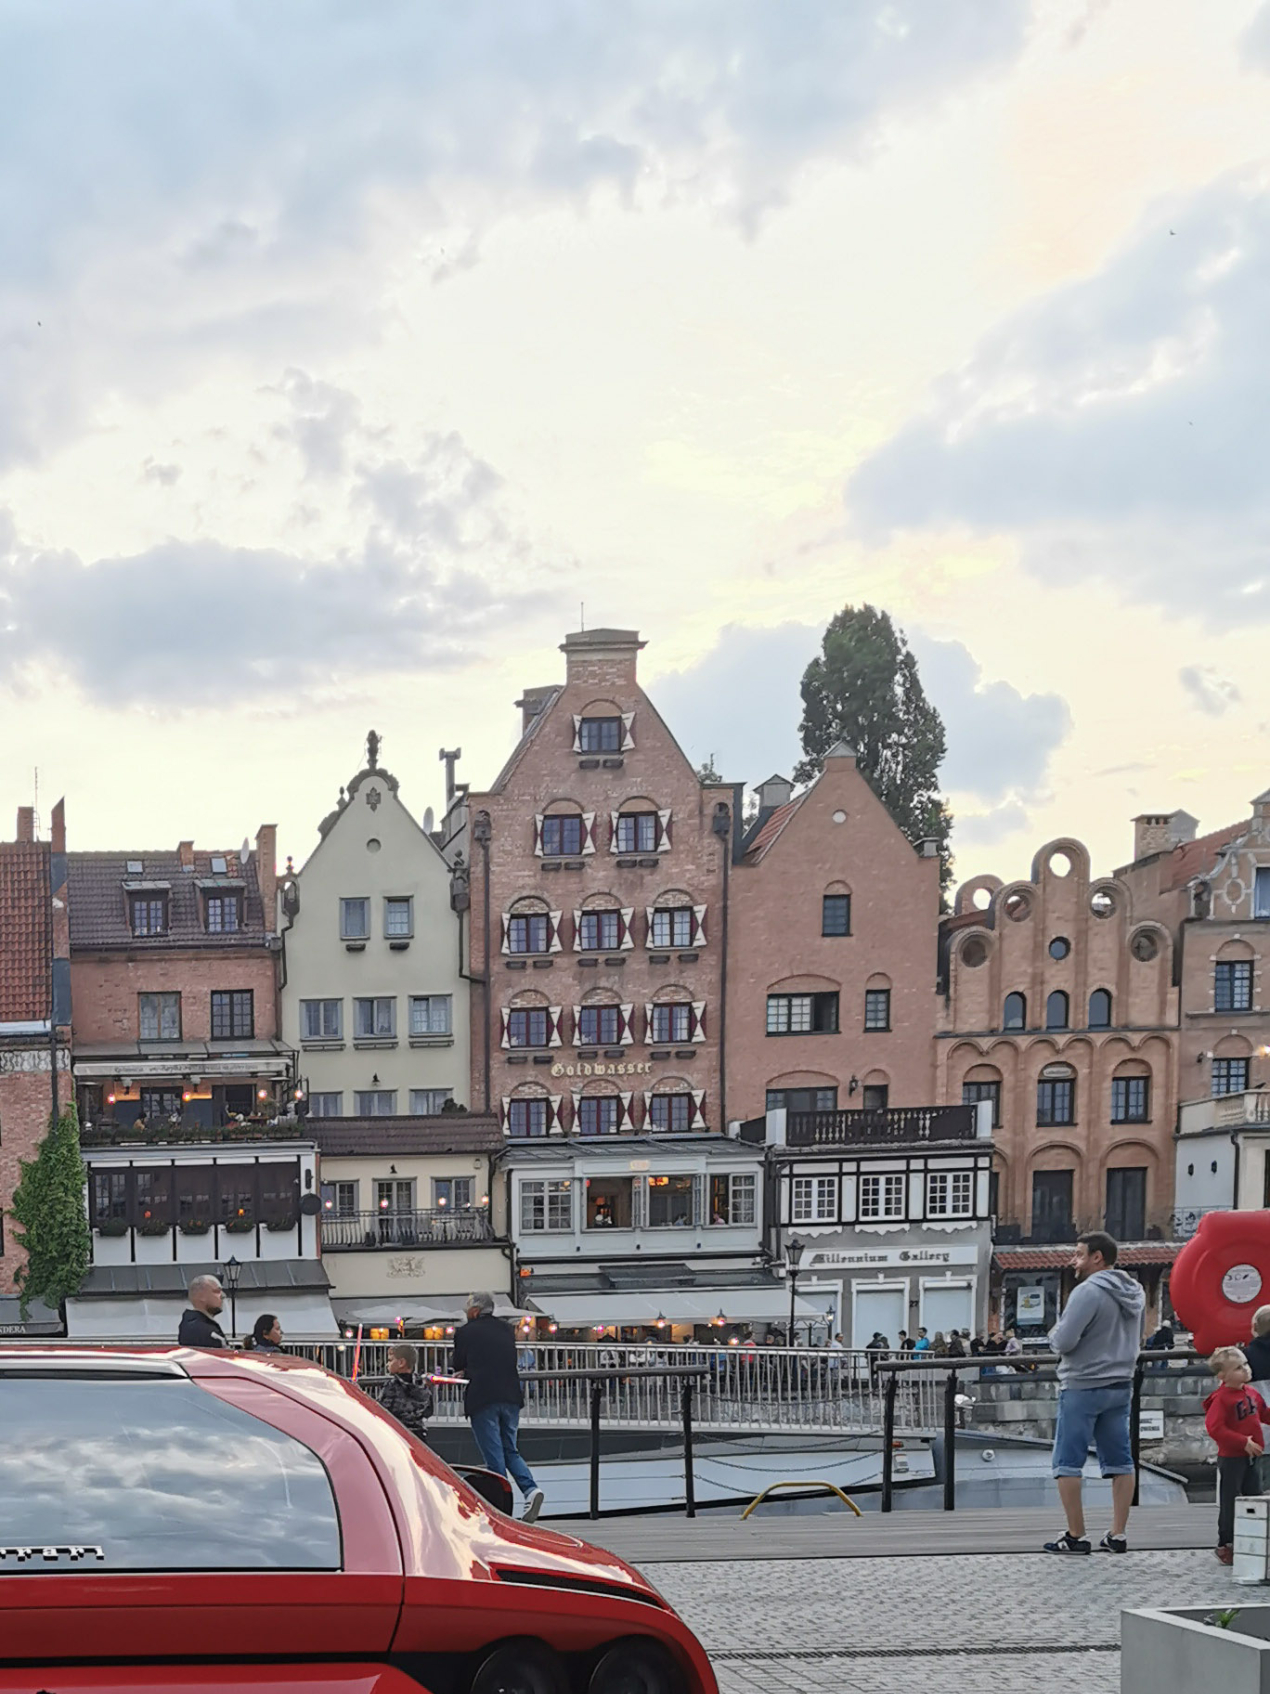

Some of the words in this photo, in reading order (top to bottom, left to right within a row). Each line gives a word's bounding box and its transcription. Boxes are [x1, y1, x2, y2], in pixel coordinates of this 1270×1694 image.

[551, 1062, 652, 1077] Goldwasser
[809, 1252, 888, 1267] Millennium
[898, 1250, 950, 1263] Gallery
